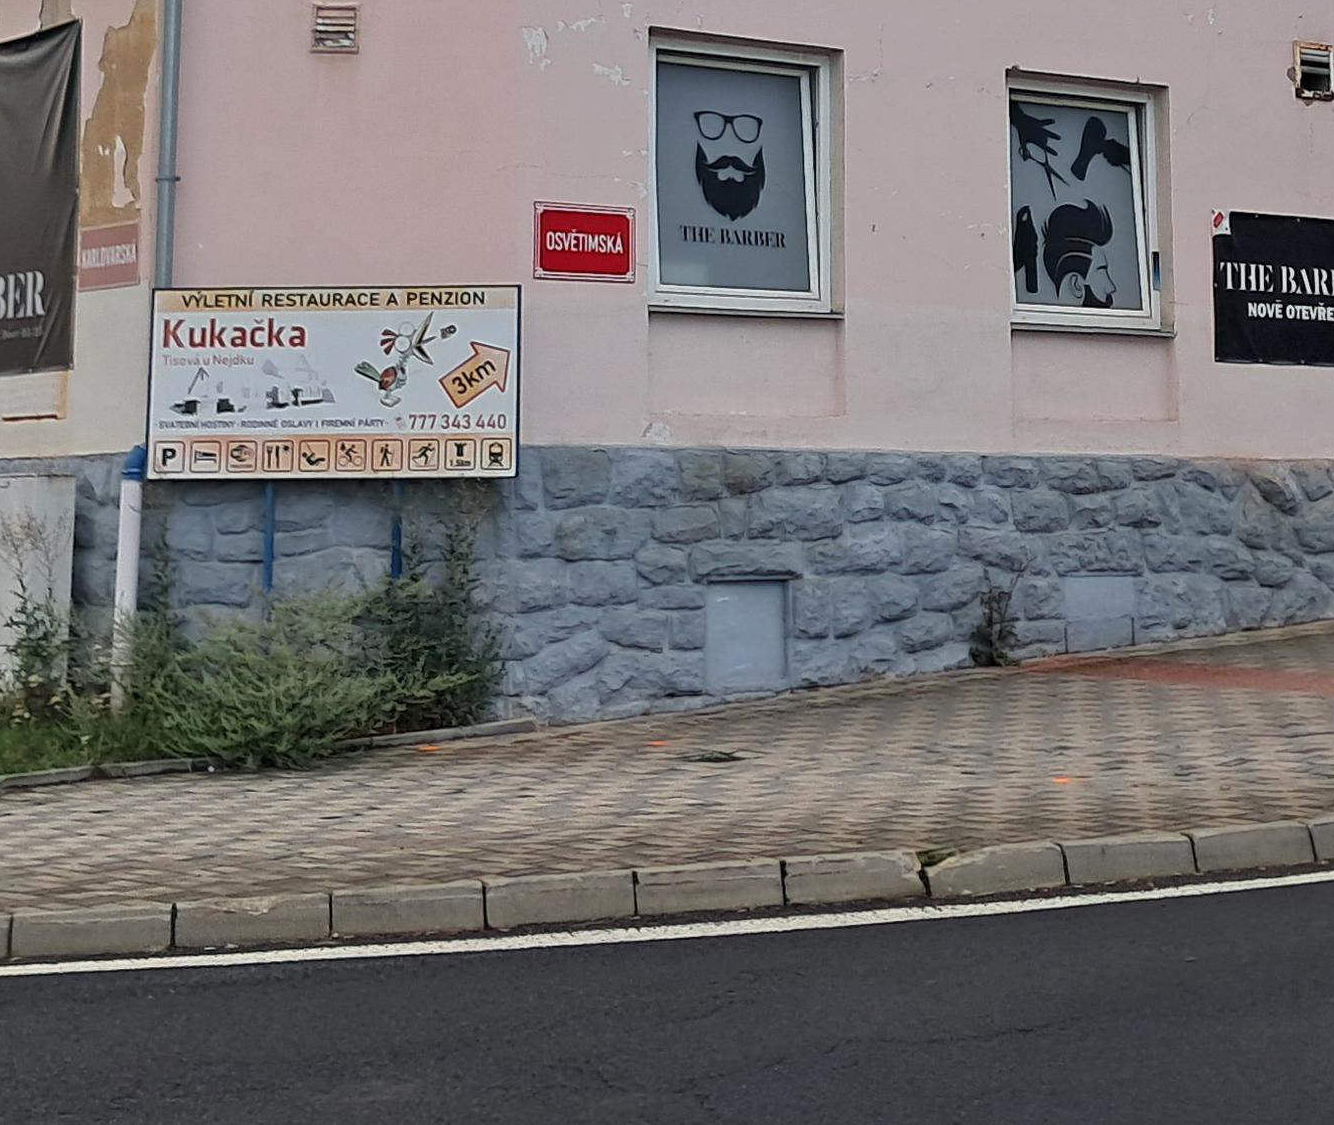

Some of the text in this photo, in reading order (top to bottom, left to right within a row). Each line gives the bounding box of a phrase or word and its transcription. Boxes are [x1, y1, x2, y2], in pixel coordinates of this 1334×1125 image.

[545, 228, 624, 254] OSVĚTIMSKÁ
[679, 225, 786, 248] THE BARBER
[1219, 261, 1274, 293] THE
[181, 290, 486, 308] VÝLETNÍ RESTAURACE A PENZION
[162, 318, 308, 349] Kukačka
[162, 355, 255, 368] Tisová u Nejdku
[451, 360, 497, 394] 3km
[408, 414, 507, 429] 777 343 440
[161, 448, 177, 466] P
